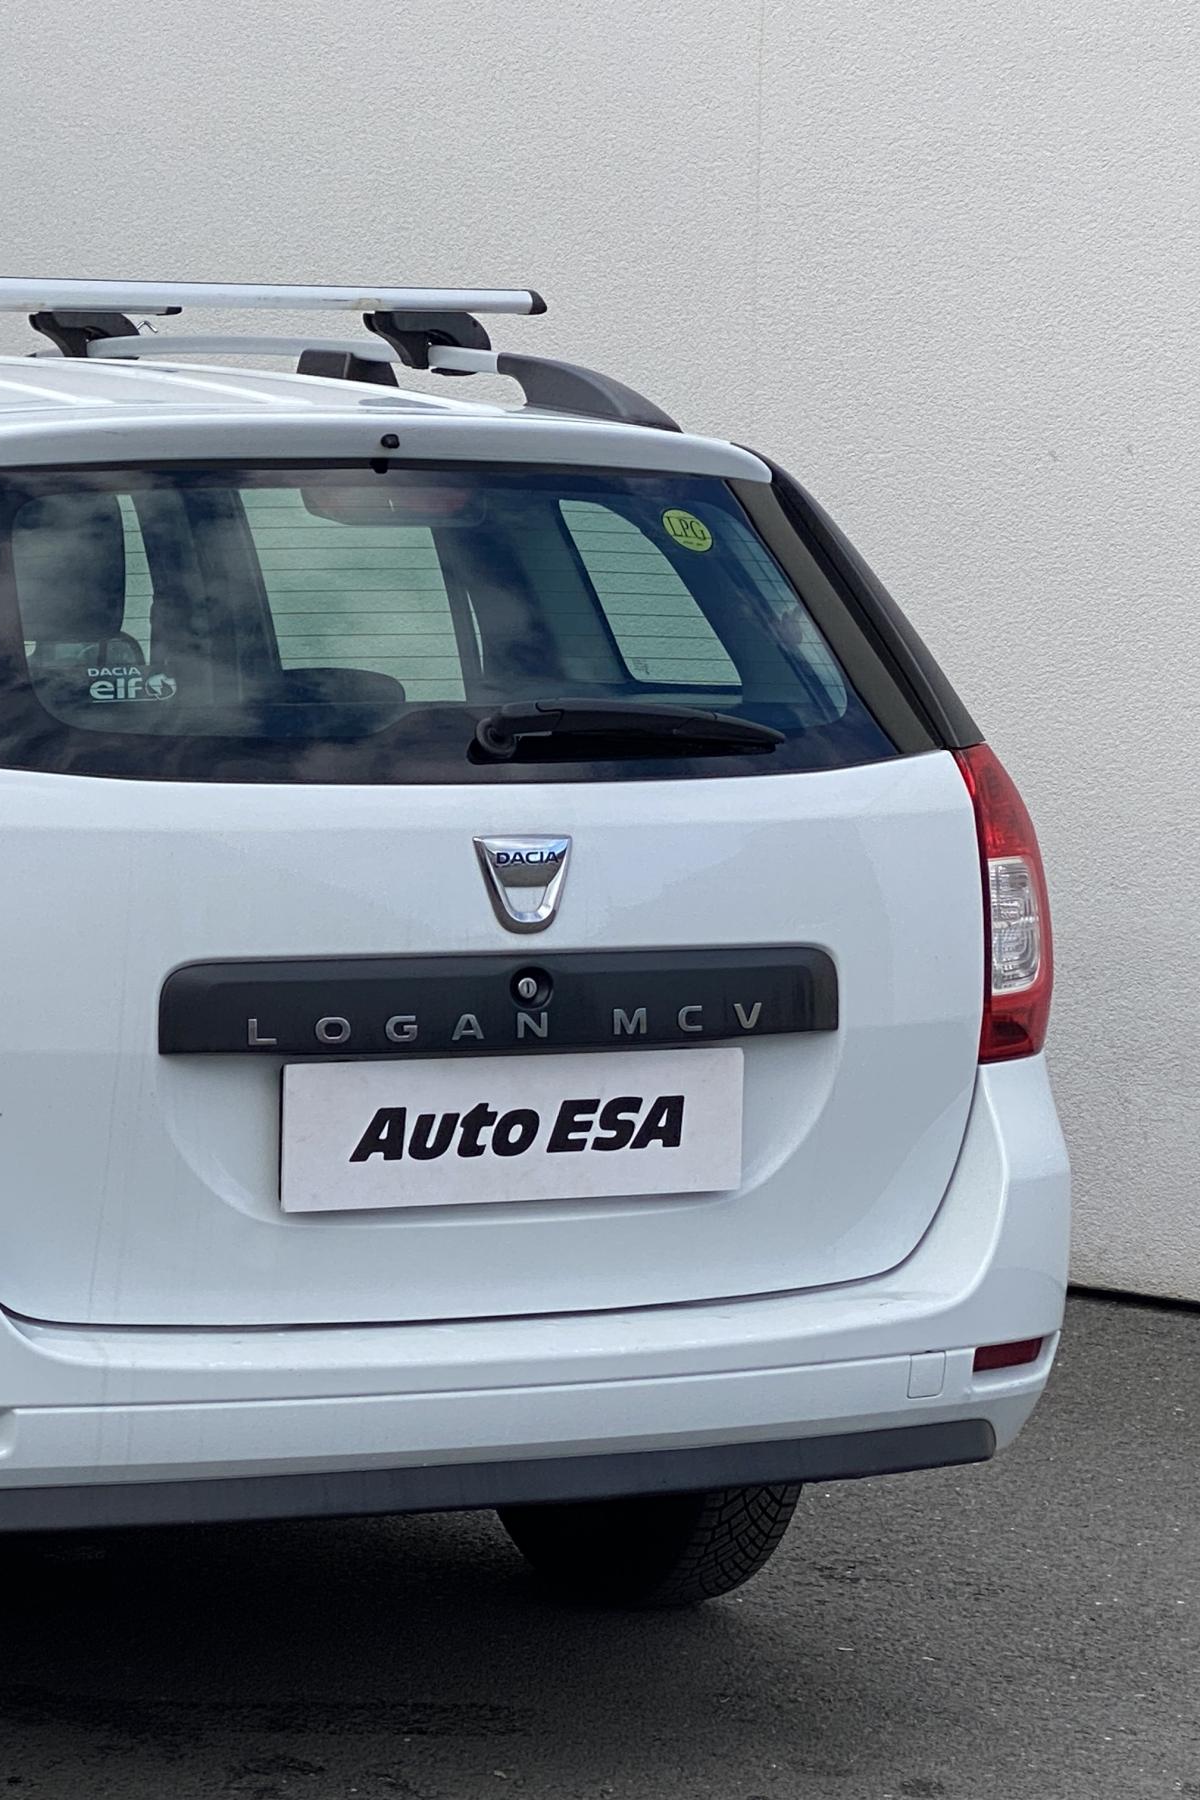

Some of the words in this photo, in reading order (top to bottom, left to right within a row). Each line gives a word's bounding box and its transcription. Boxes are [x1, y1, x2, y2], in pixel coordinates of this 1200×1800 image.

[666, 516, 706, 540] LPG
[87, 667, 141, 677] DACIA
[89, 677, 143, 699] elf
[496, 851, 559, 864] DACIA
[247, 1011, 549, 1046] LOGAN
[612, 1003, 762, 1035] MCV
[349, 1103, 540, 1162] Auto
[546, 1095, 685, 1153] ESA
